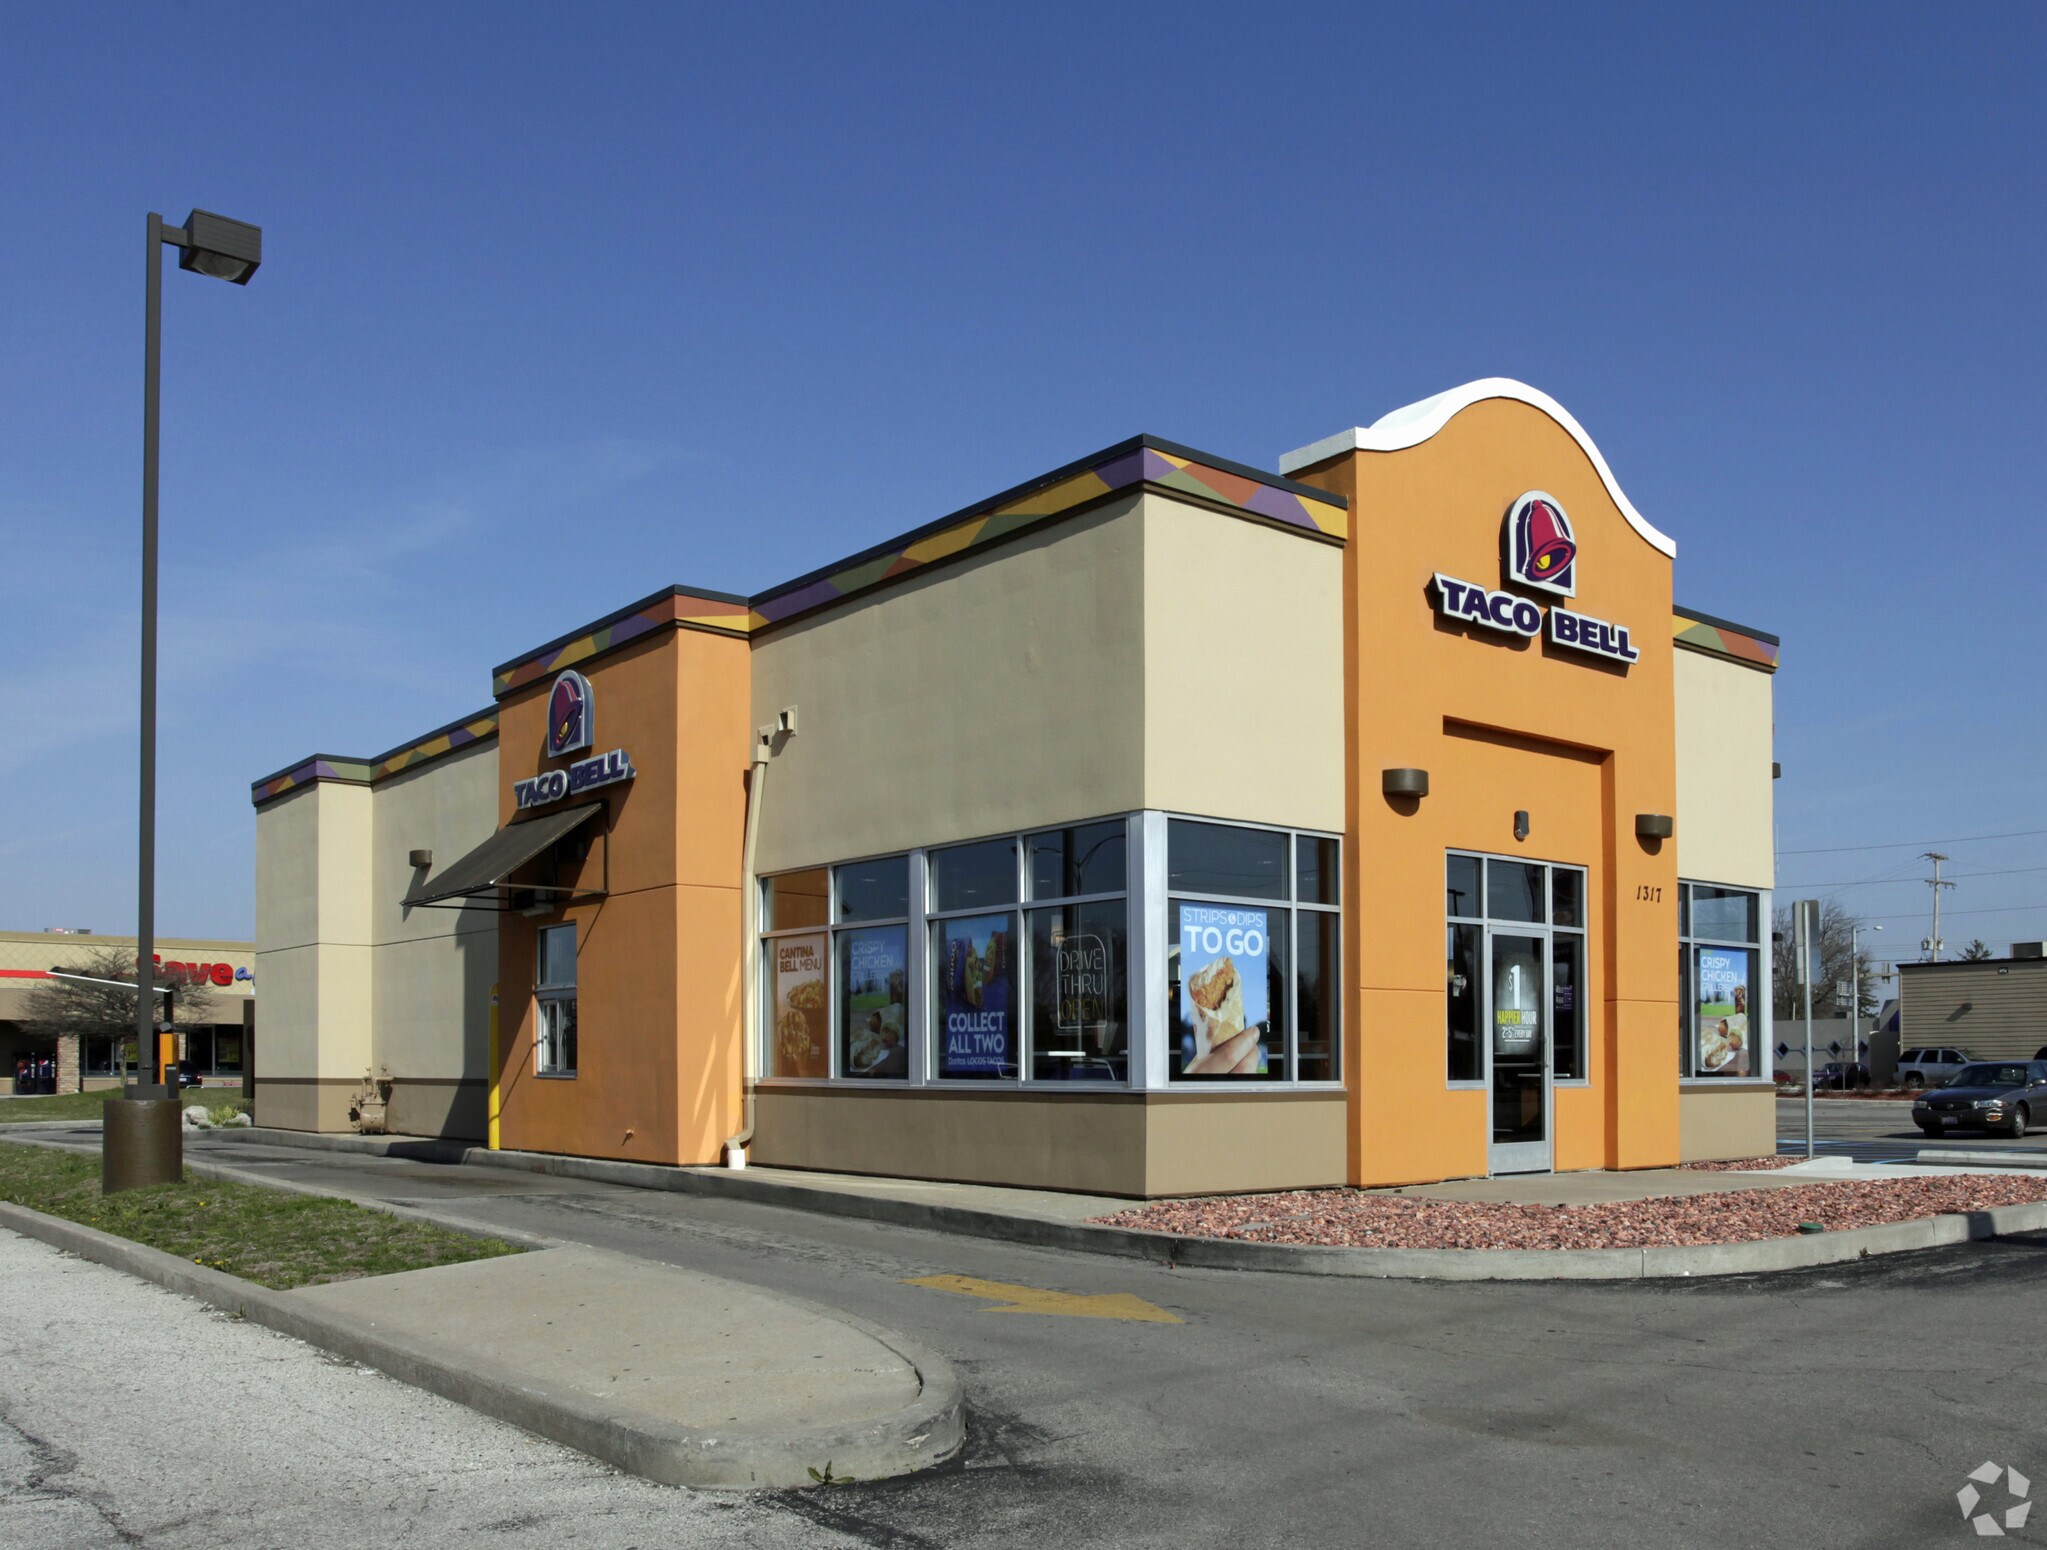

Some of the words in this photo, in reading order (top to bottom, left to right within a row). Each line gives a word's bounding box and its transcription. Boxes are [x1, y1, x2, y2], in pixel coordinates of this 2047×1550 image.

[1440, 578, 1541, 633] TACO
[1554, 611, 1638, 660] BELL
[514, 773, 566, 807] TACO
[571, 752, 626, 792] BELL
[1636, 885, 1662, 903] 1317
[1183, 908, 1228, 925] STRIPS
[1237, 912, 1264, 928] DIPS
[851, 941, 885, 954] CRISPY
[1184, 925, 1223, 954] TO
[1226, 928, 1264, 957] GO
[780, 945, 814, 960] CANTINA
[852, 954, 893, 970] CHICKEN
[1060, 948, 1103, 972] DRIVE
[780, 959, 798, 973] BELL
[799, 957, 822, 972] MENU
[1701, 956, 1731, 970] CRISPY
[1062, 974, 1104, 995] THRU
[1701, 970, 1738, 982] CHICKEN
[1062, 998, 1104, 1020] OPEN
[1497, 1010, 1521, 1024] HAPPIER
[1521, 1010, 1537, 1025] HOUR
[948, 1011, 1005, 1032] COLLECT
[948, 1034, 972, 1053] ALL
[974, 1033, 1005, 1053] TWO
[967, 1056, 986, 1066] LOCOS
